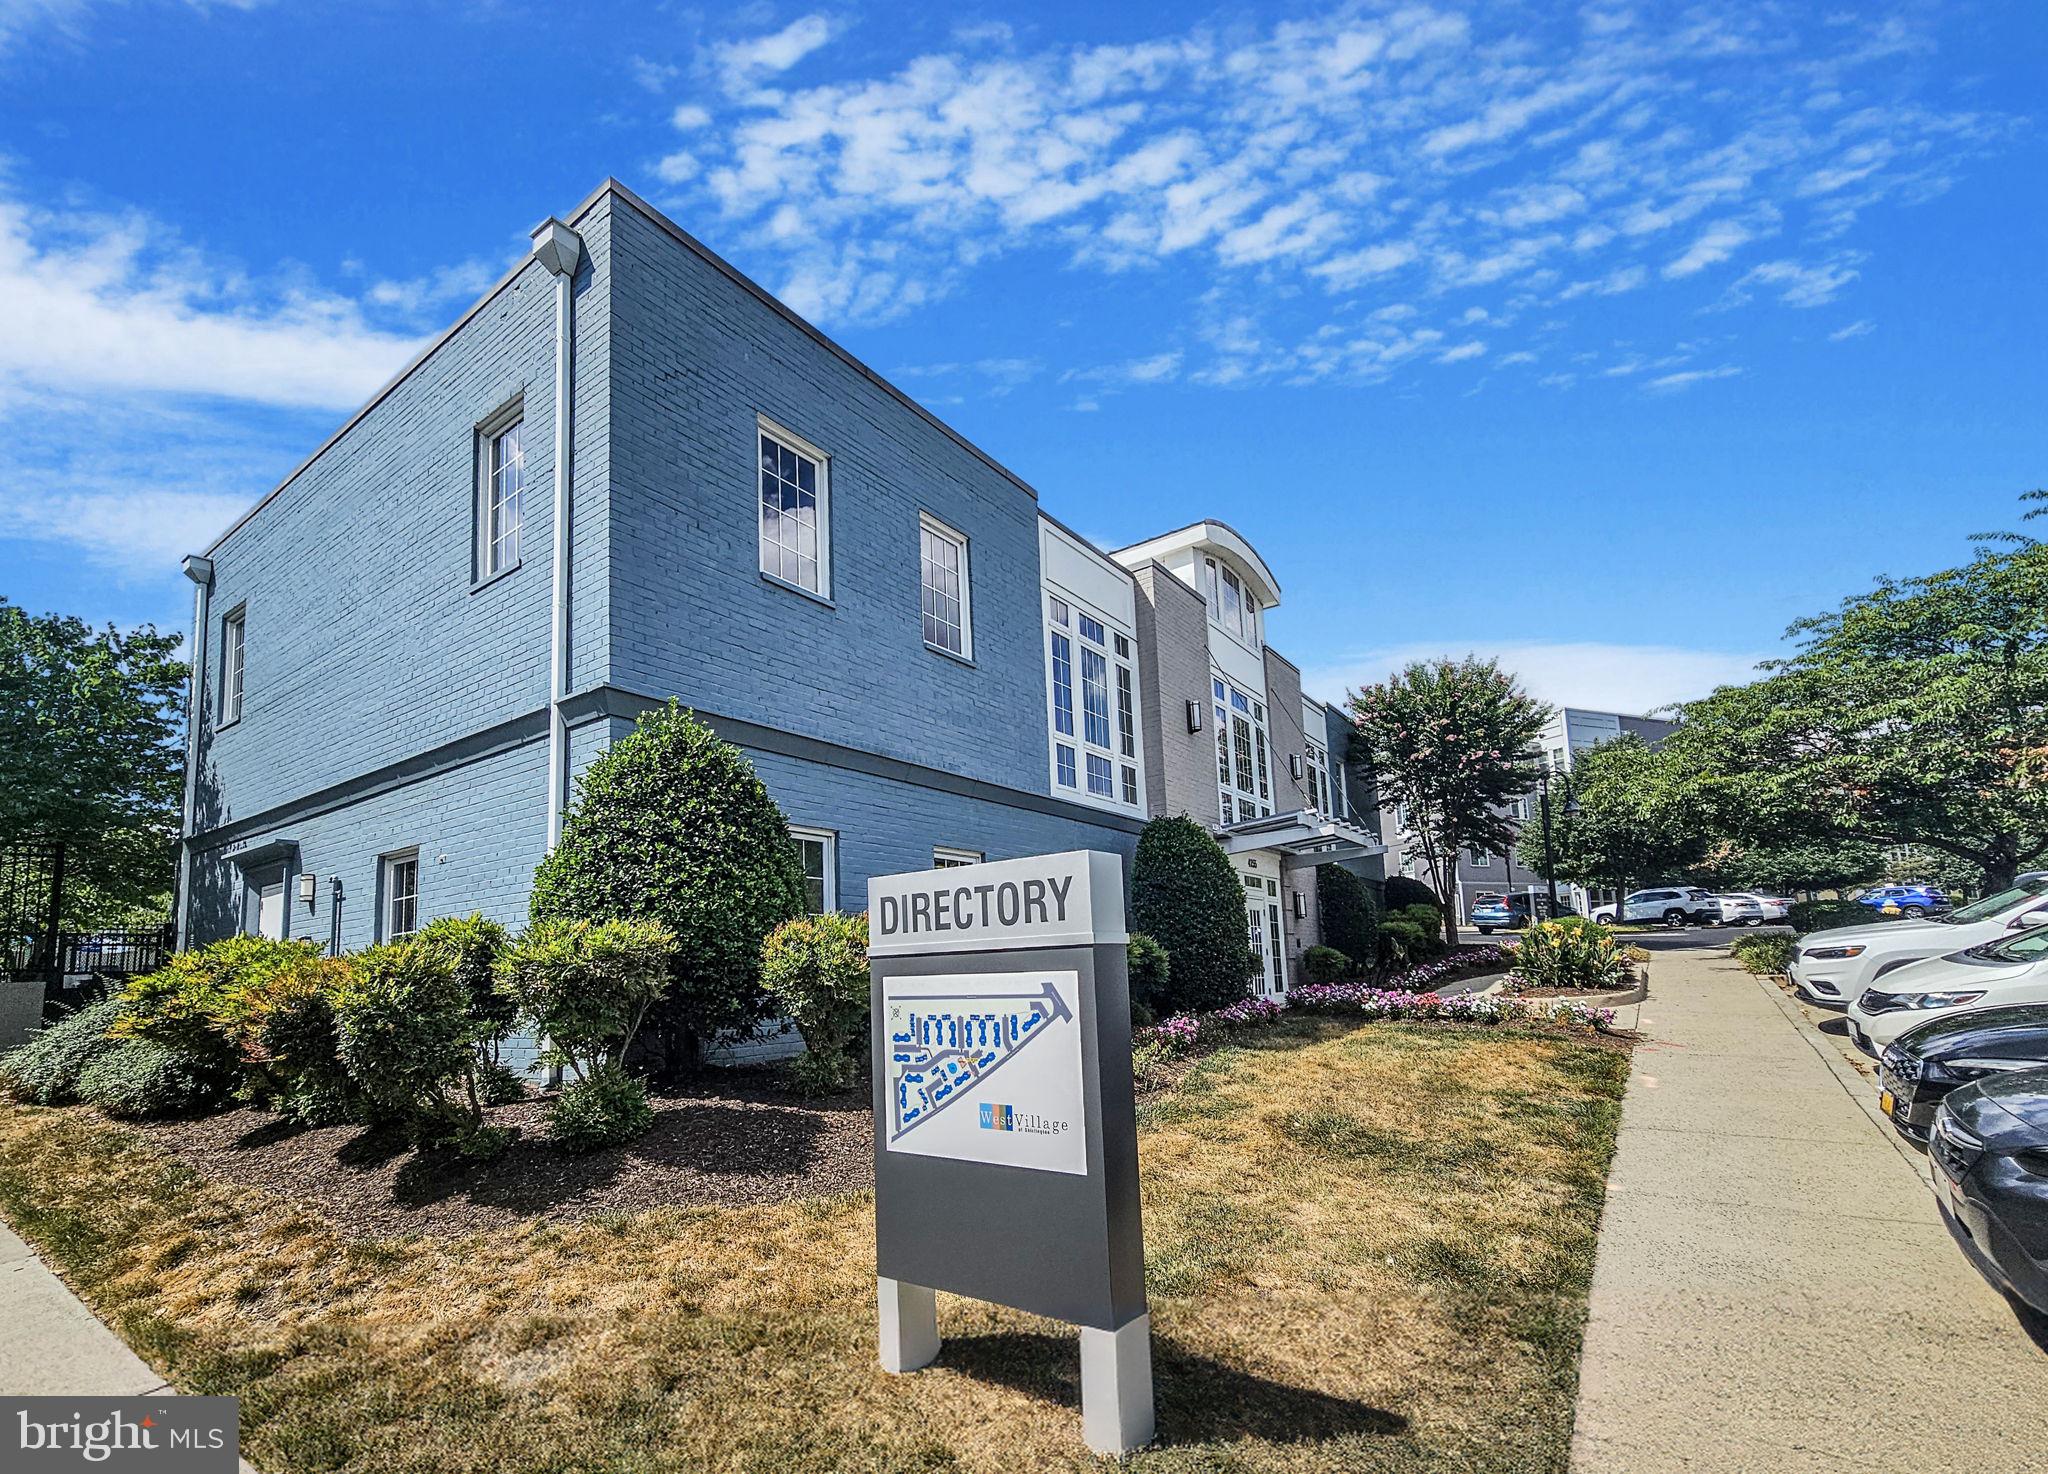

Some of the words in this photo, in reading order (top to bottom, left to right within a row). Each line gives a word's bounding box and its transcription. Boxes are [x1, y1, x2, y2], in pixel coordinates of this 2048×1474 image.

[880, 876, 1073, 935] DIRECTORY
[980, 1110, 1013, 1126] West
[1014, 1113, 1068, 1135] Village
